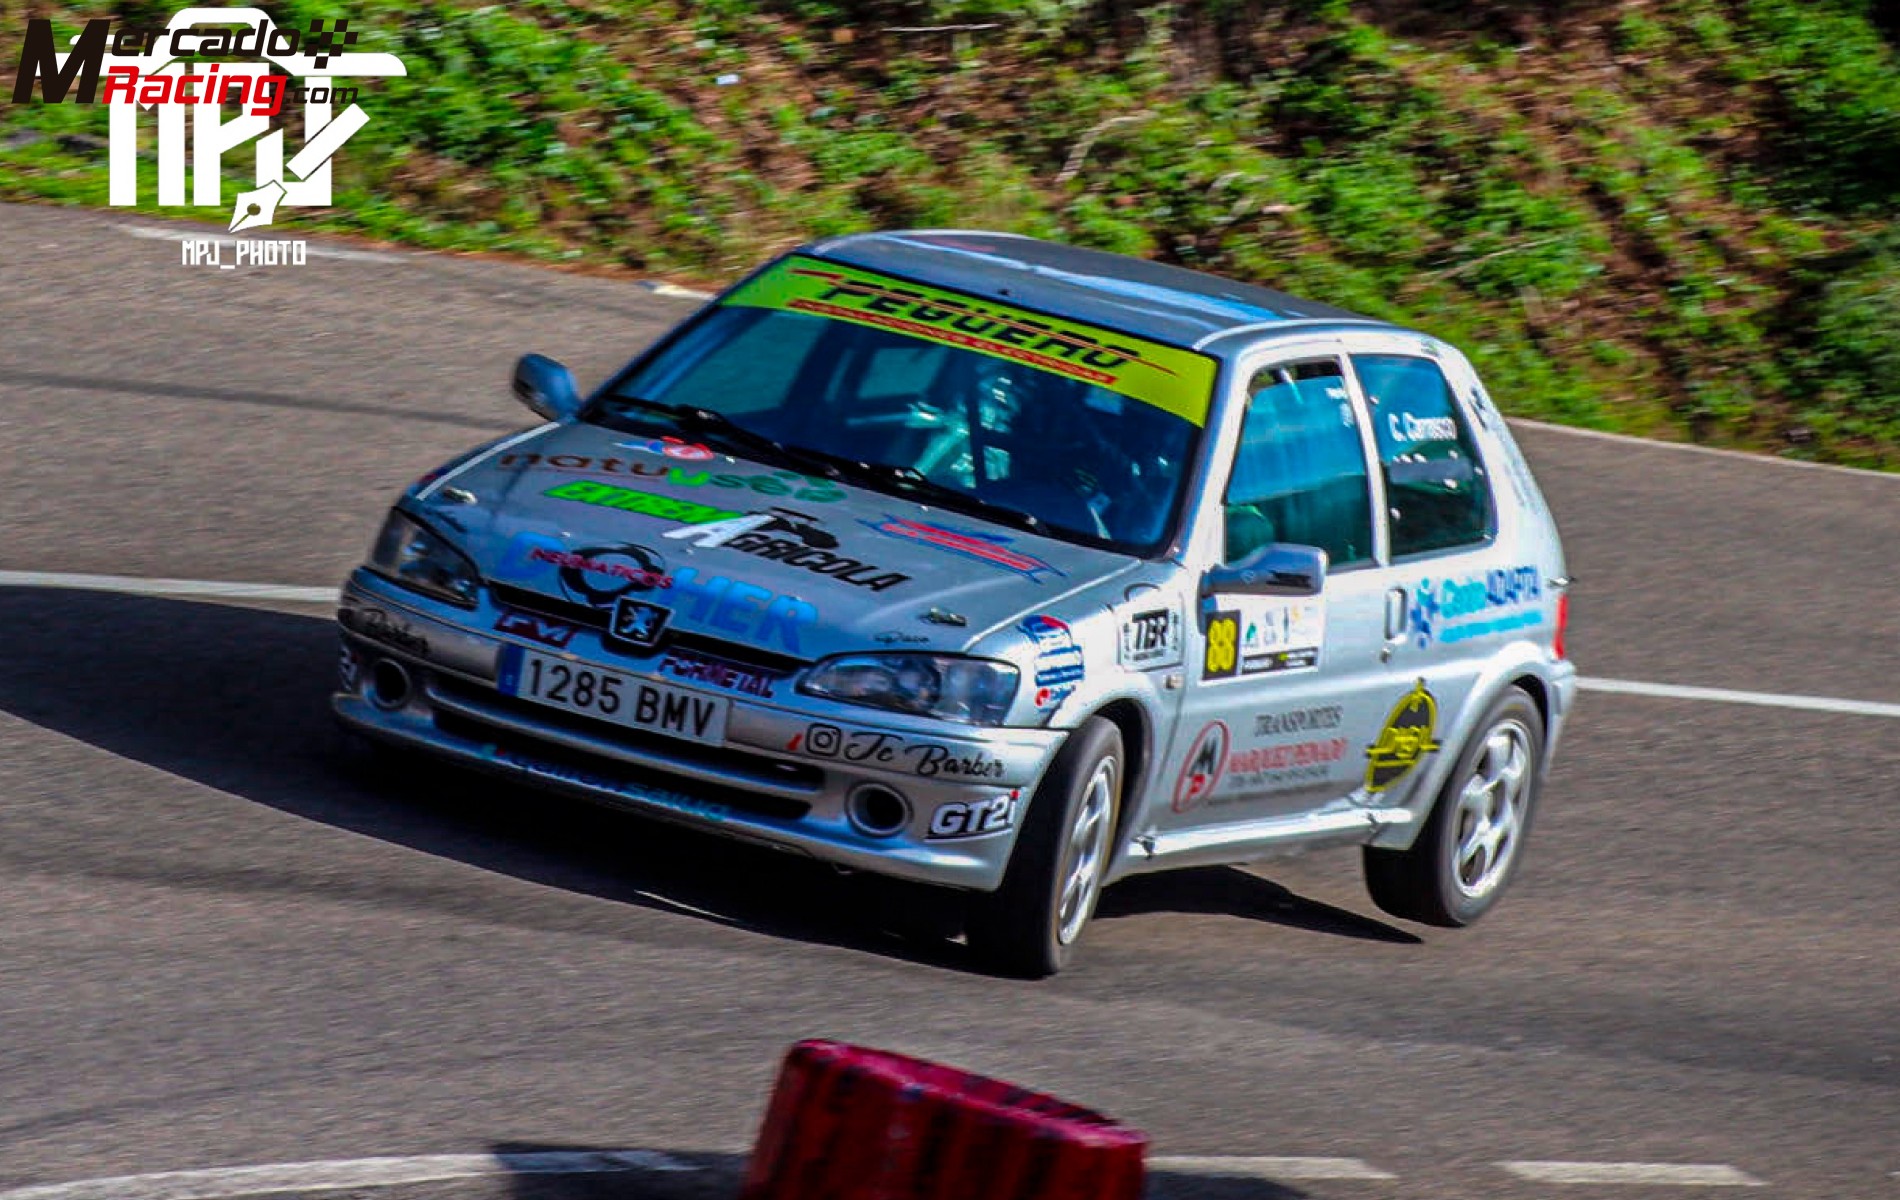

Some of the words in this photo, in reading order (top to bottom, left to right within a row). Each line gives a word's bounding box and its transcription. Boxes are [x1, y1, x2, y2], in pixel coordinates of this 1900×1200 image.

[1207, 617, 1238, 673] 88
[529, 657, 623, 714] 1285
[634, 685, 716, 738] BMV
